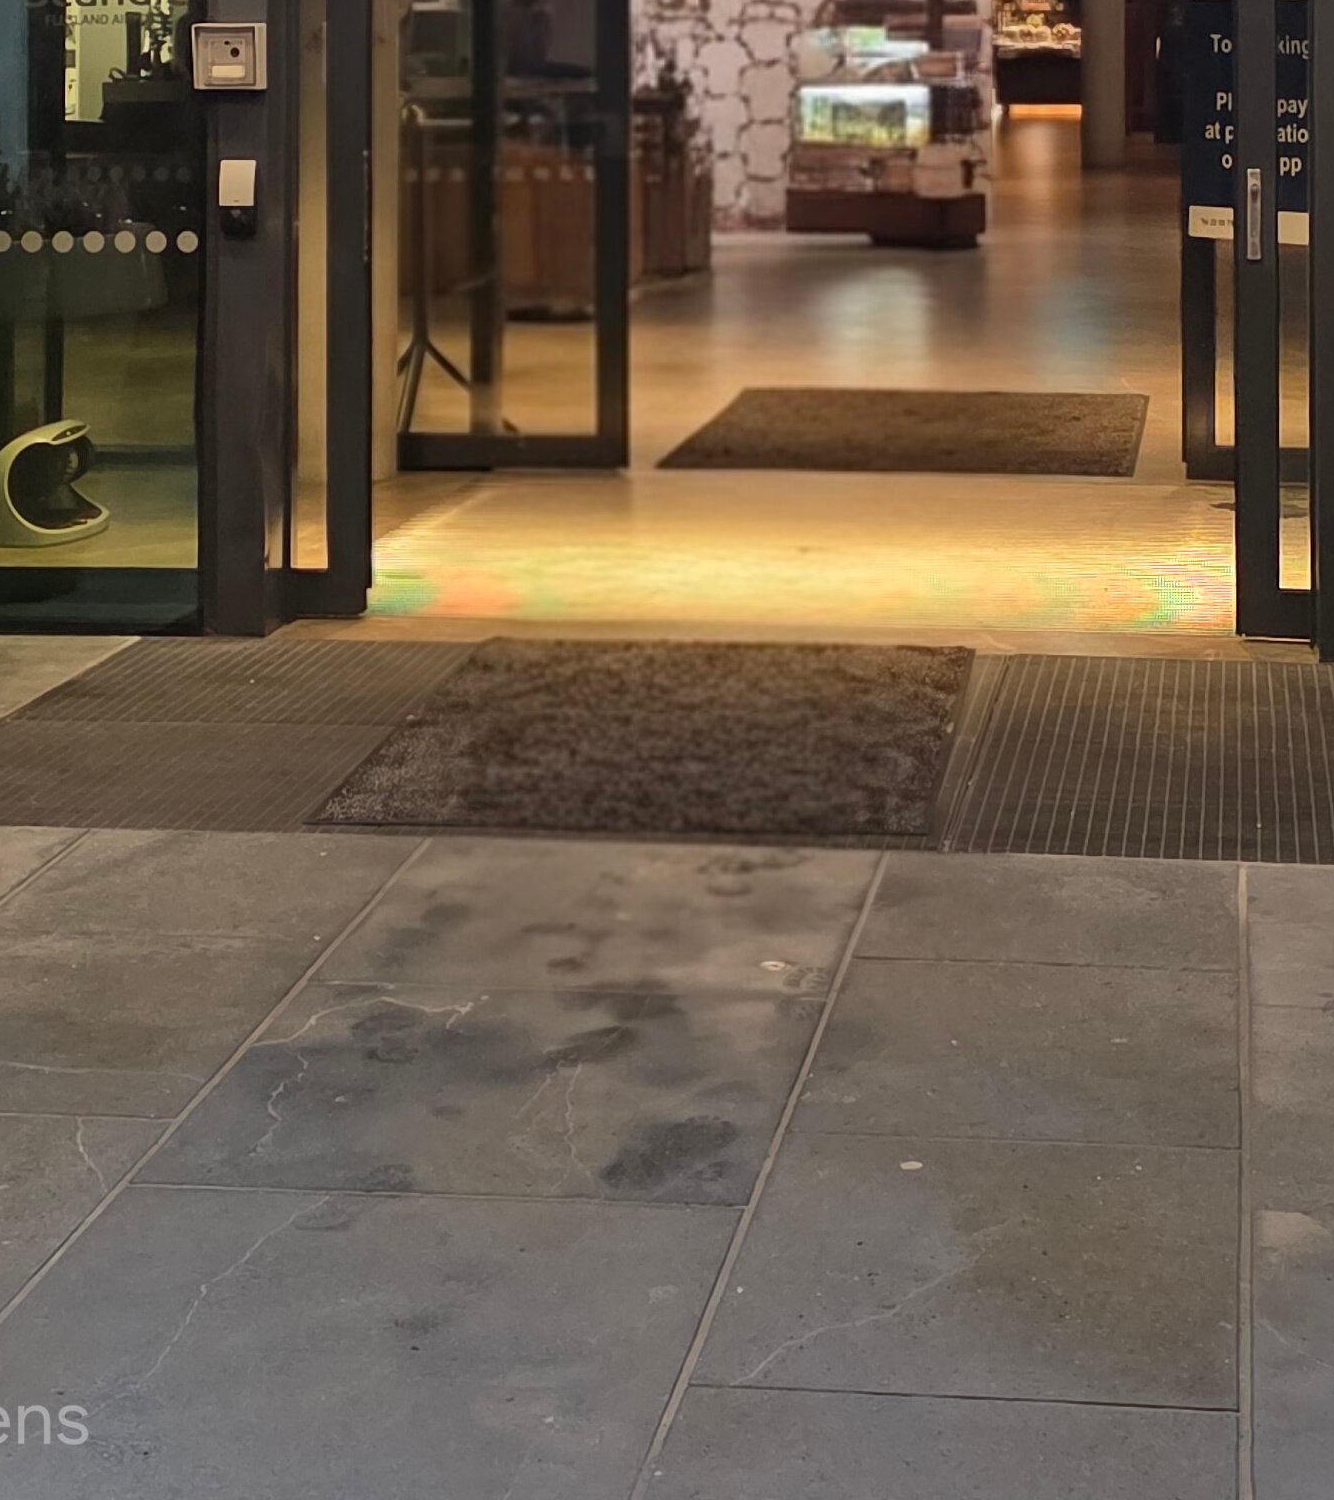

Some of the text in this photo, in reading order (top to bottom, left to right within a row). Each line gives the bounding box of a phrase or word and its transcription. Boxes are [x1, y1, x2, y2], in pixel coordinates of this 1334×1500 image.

[1210, 33, 1233, 53] To
[1277, 99, 1309, 119] pay
[1205, 122, 1221, 140] at
